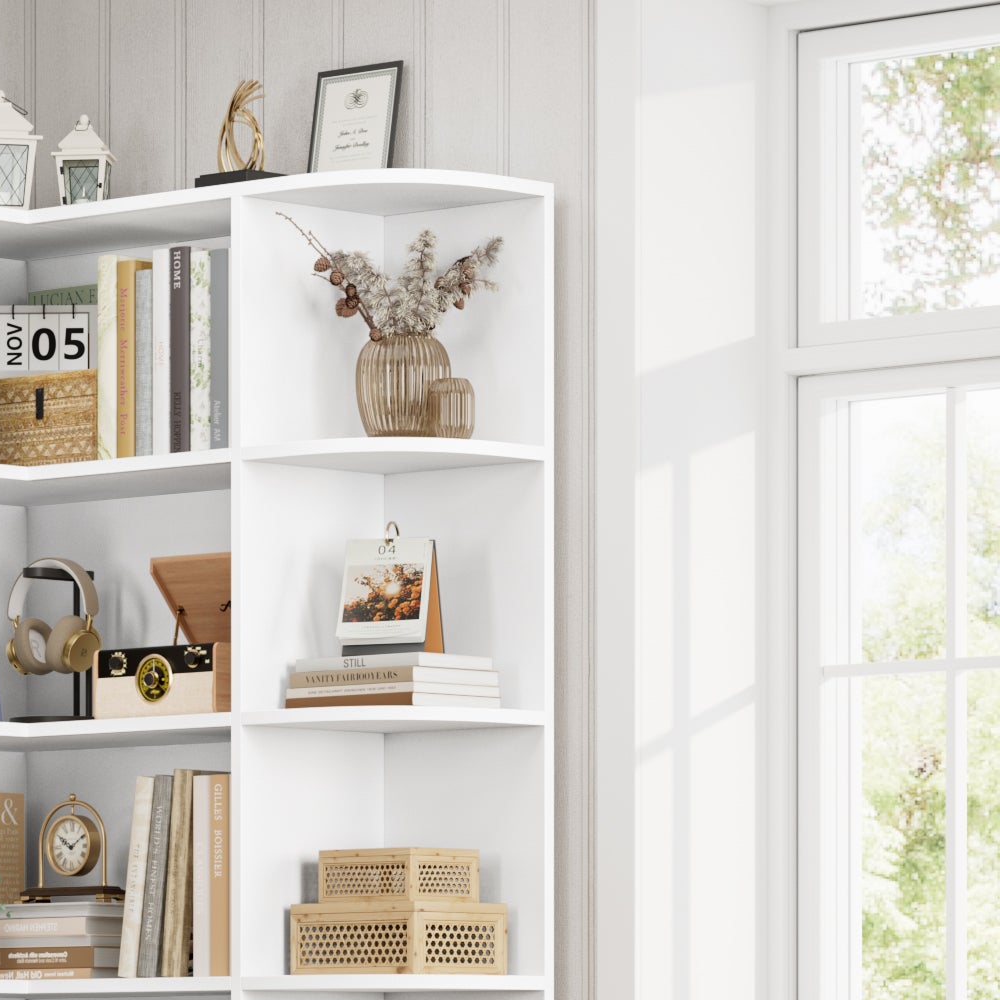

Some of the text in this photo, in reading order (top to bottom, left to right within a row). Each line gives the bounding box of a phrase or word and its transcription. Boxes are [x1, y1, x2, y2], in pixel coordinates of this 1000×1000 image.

[173, 250, 181, 290] HOME
[119, 288, 128, 331] Marjorie
[6, 322, 22, 365] NOV
[119, 413, 128, 435] Post
[173, 392, 182, 452] KELLY HOPPEN
[377, 545, 396, 555] 04
[343, 658, 366, 668] STILL
[1, 799, 18, 826] &
[214, 783, 222, 878] GILLES BOISSIER
